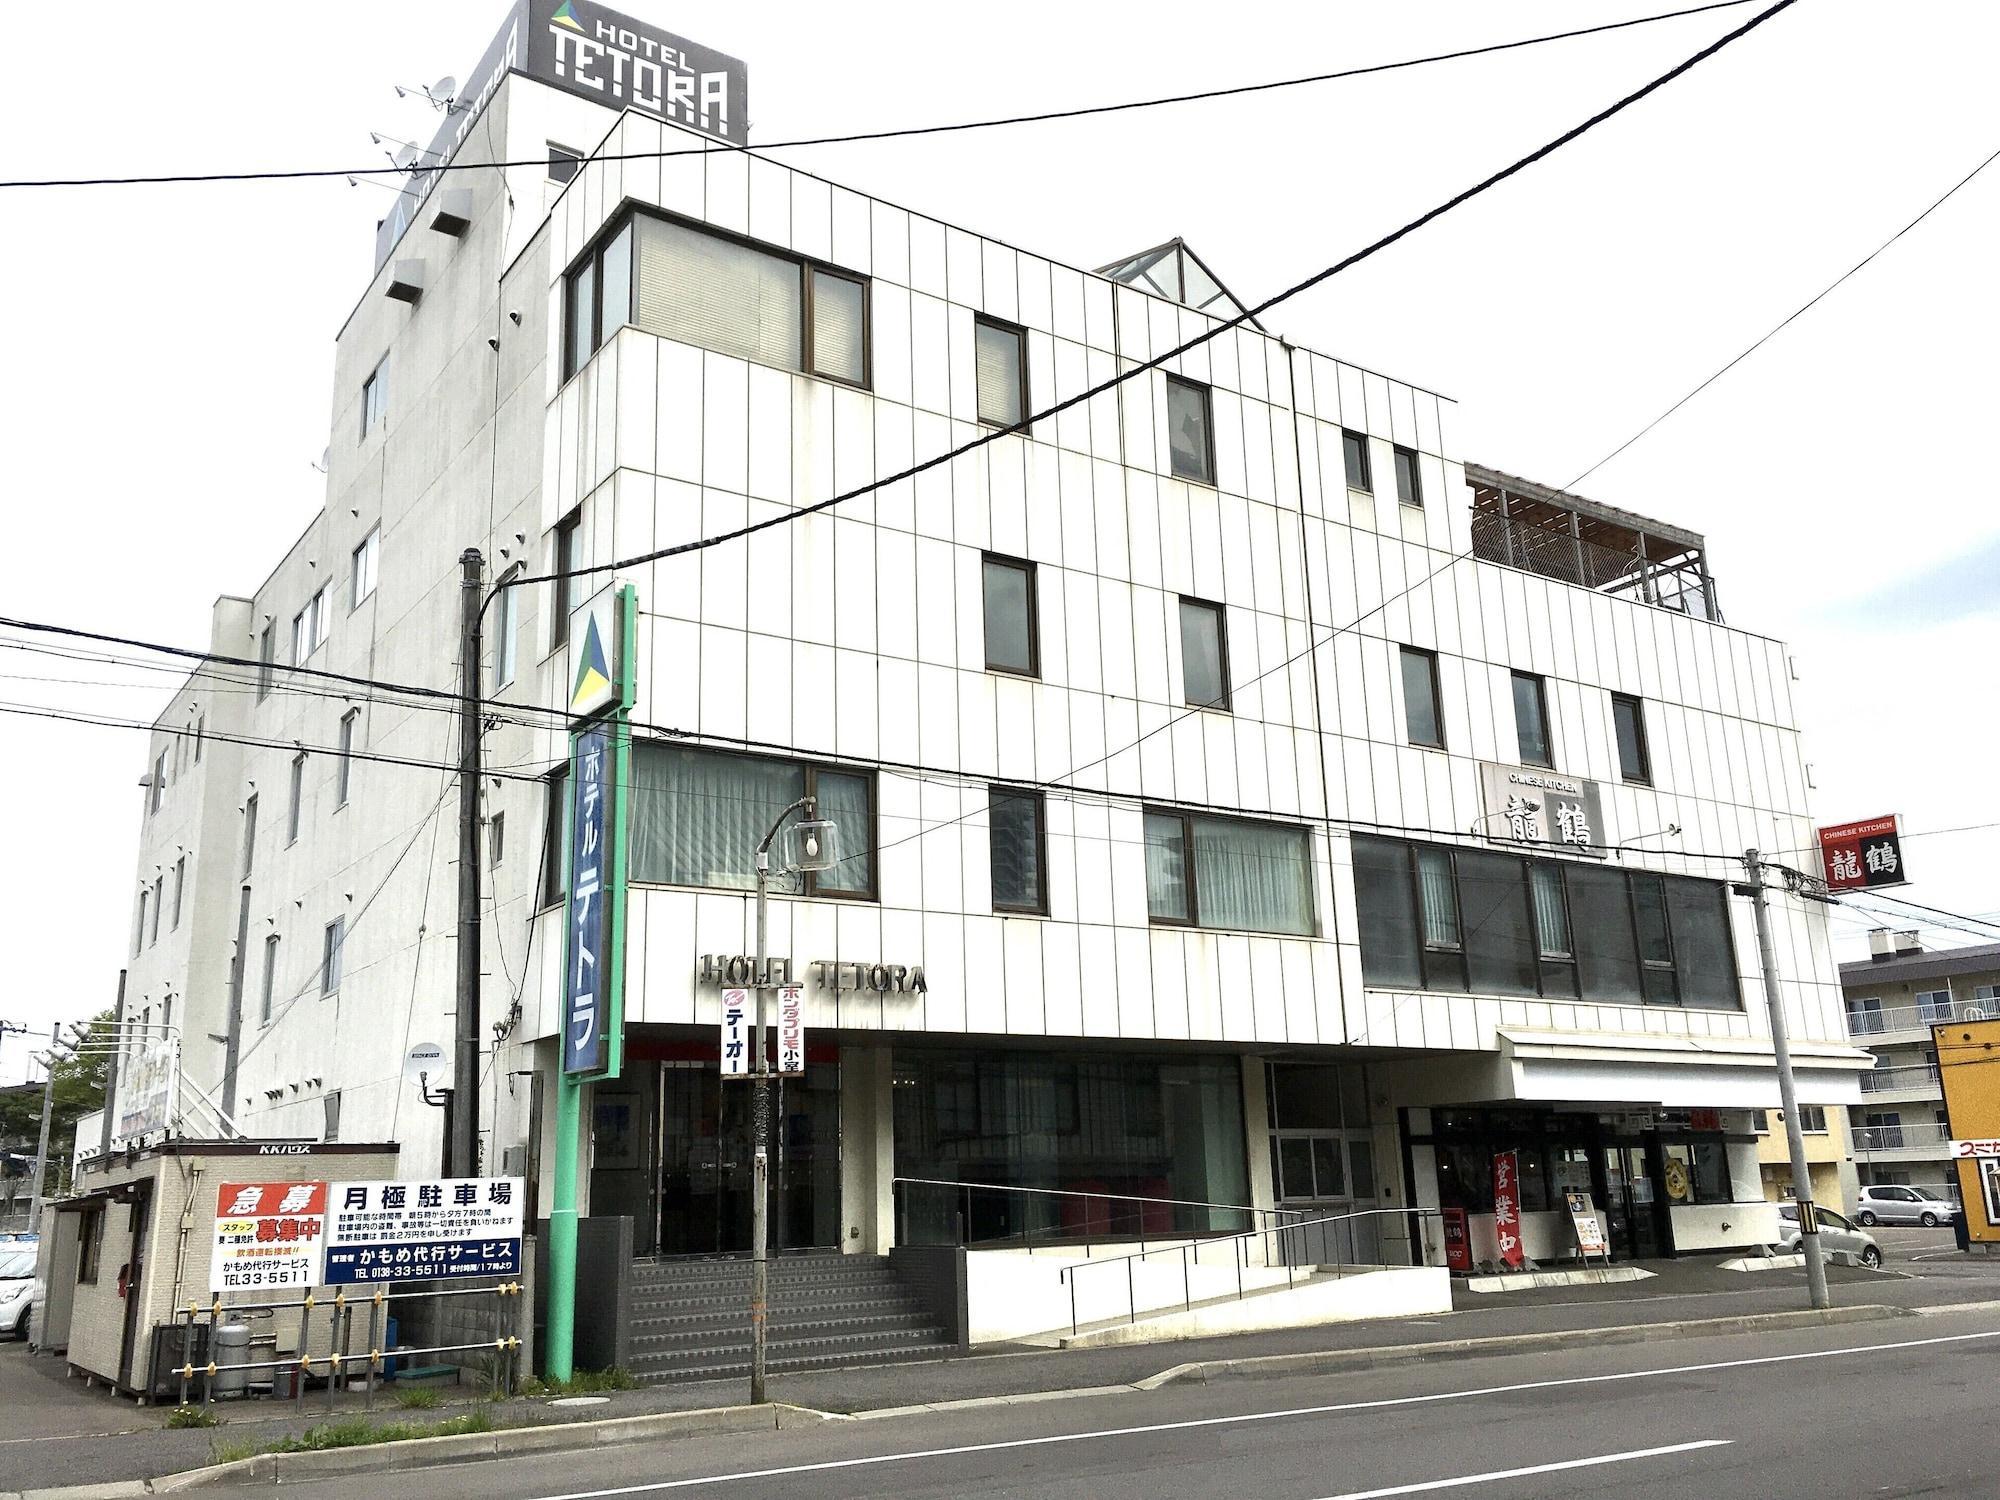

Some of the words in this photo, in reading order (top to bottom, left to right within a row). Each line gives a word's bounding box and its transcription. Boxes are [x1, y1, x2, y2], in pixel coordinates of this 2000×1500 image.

[596, 19, 695, 74] HOTEL
[549, 24, 728, 136] TETORA
[1509, 773, 1544, 788] CHINESE
[1544, 780, 1577, 793] KITCHEN
[1824, 828, 1857, 840] CHINESE
[1858, 821, 1893, 833] KITCHEN
[1829, 842, 1897, 880] 龍鶴
[813, 960, 928, 993] TETORA
[726, 1009, 743, 1072] テーオー
[259, 1145, 310, 1154] KKハウス
[226, 1185, 318, 1214] 急募
[344, 1182, 512, 1210] 月極駐車場
[1496, 1160, 1517, 1252] 営業中
[223, 1223, 254, 1231] スタッフ
[256, 1217, 321, 1242] 募集中
[223, 1259, 309, 1272] かもめ代行サービス
[359, 1241, 512, 1265] かもめ代行サービス
[354, 1268, 368, 1279] TEL
[371, 1263, 447, 1278] 0138-33-5511
